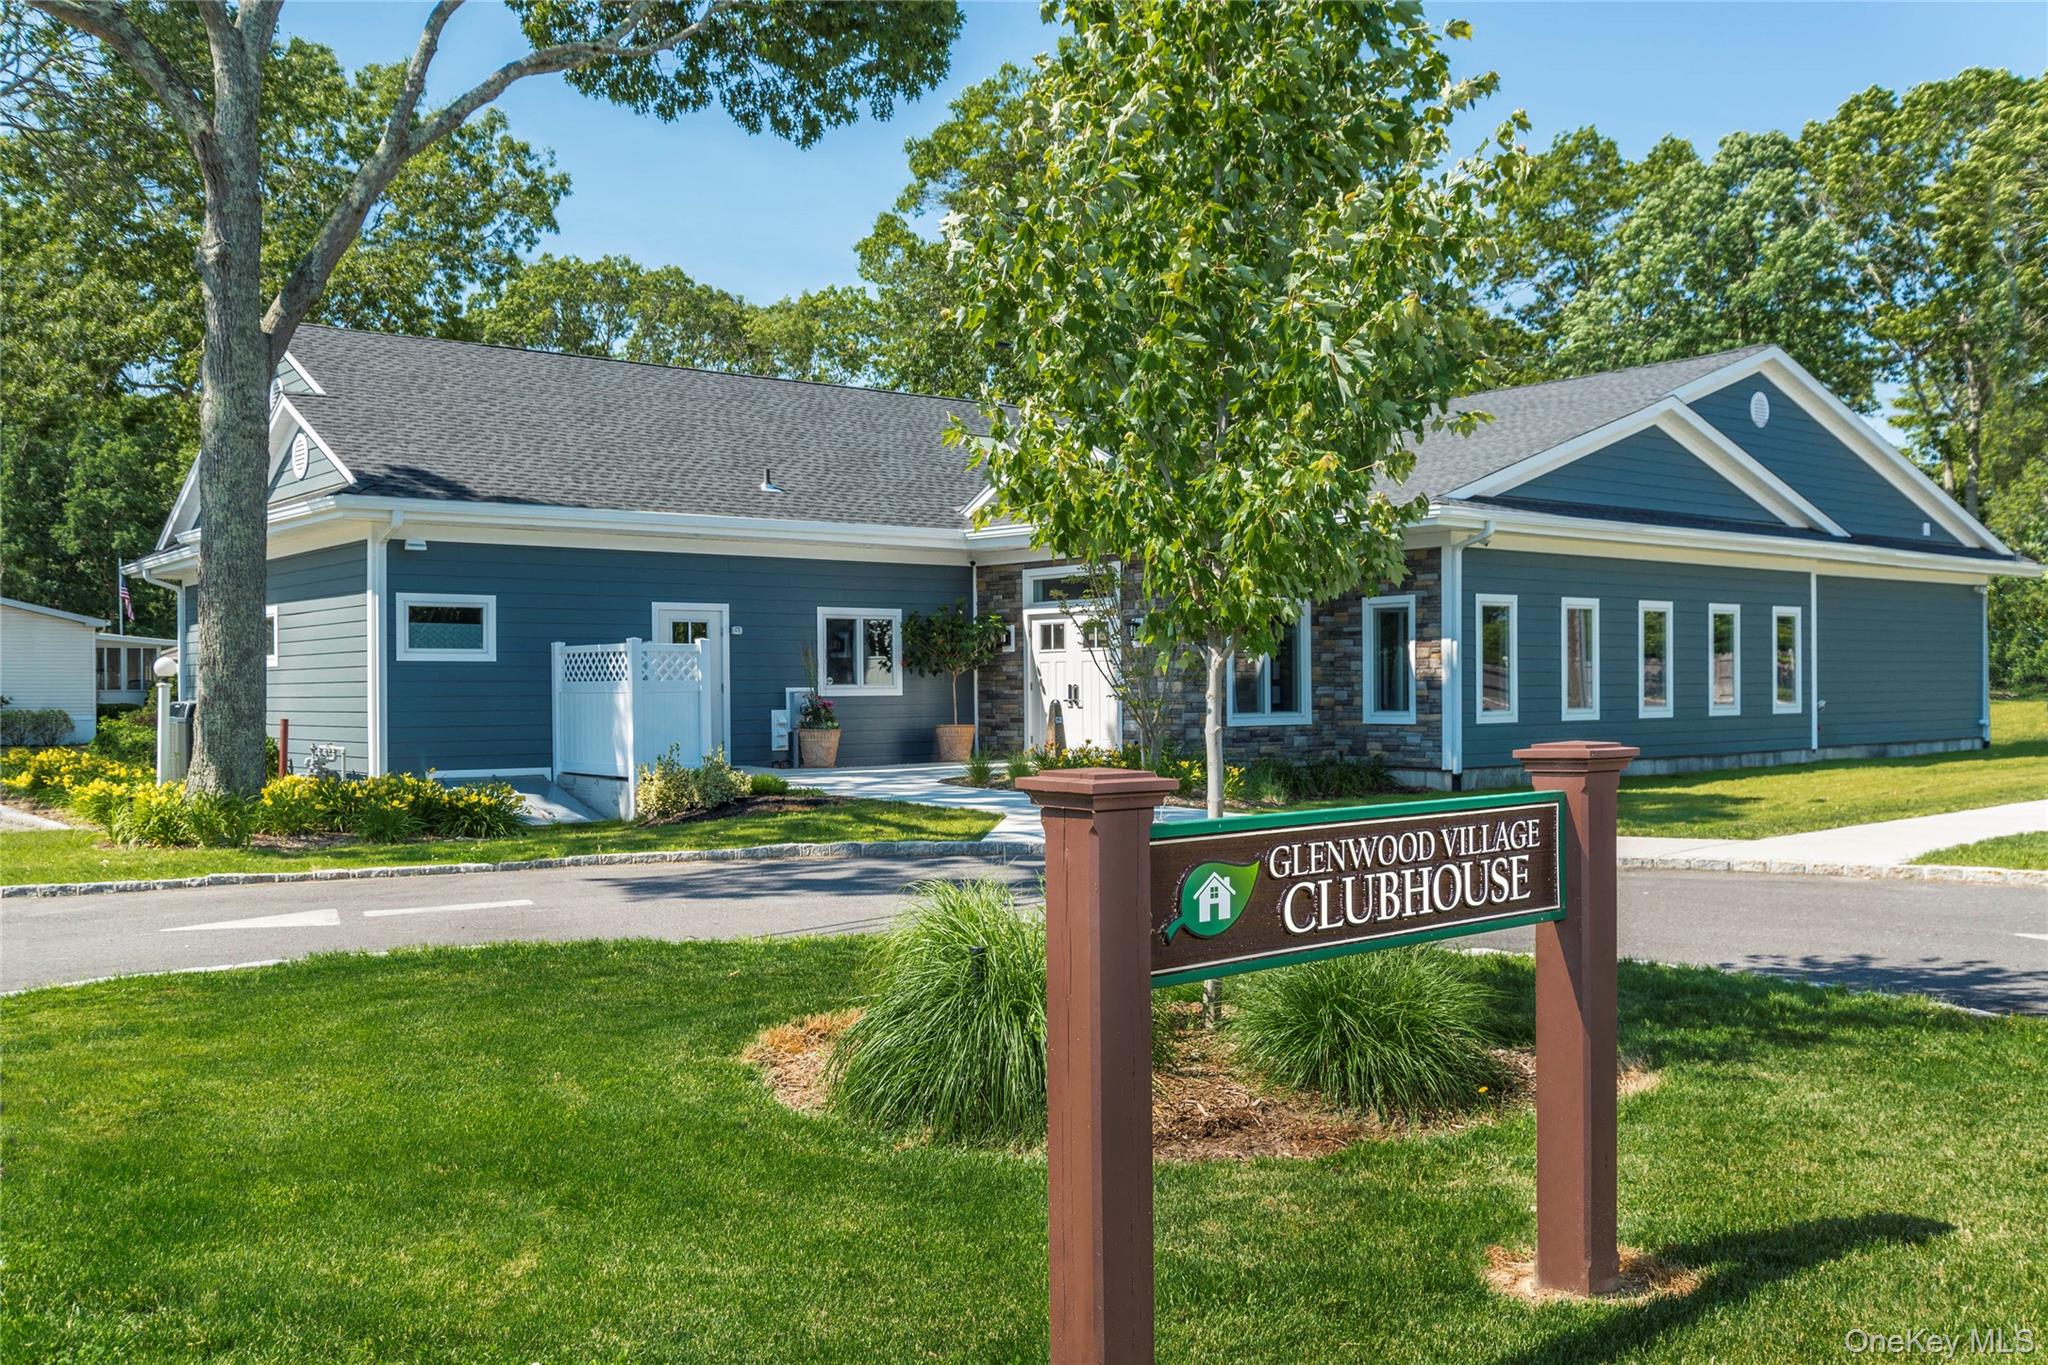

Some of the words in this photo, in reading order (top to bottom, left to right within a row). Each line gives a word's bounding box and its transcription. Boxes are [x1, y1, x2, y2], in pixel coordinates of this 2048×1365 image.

[1269, 830, 1434, 878] GLENWOOD
[1443, 819, 1540, 857] VILLAGE
[1283, 855, 1531, 934] CLUBHOUSE
